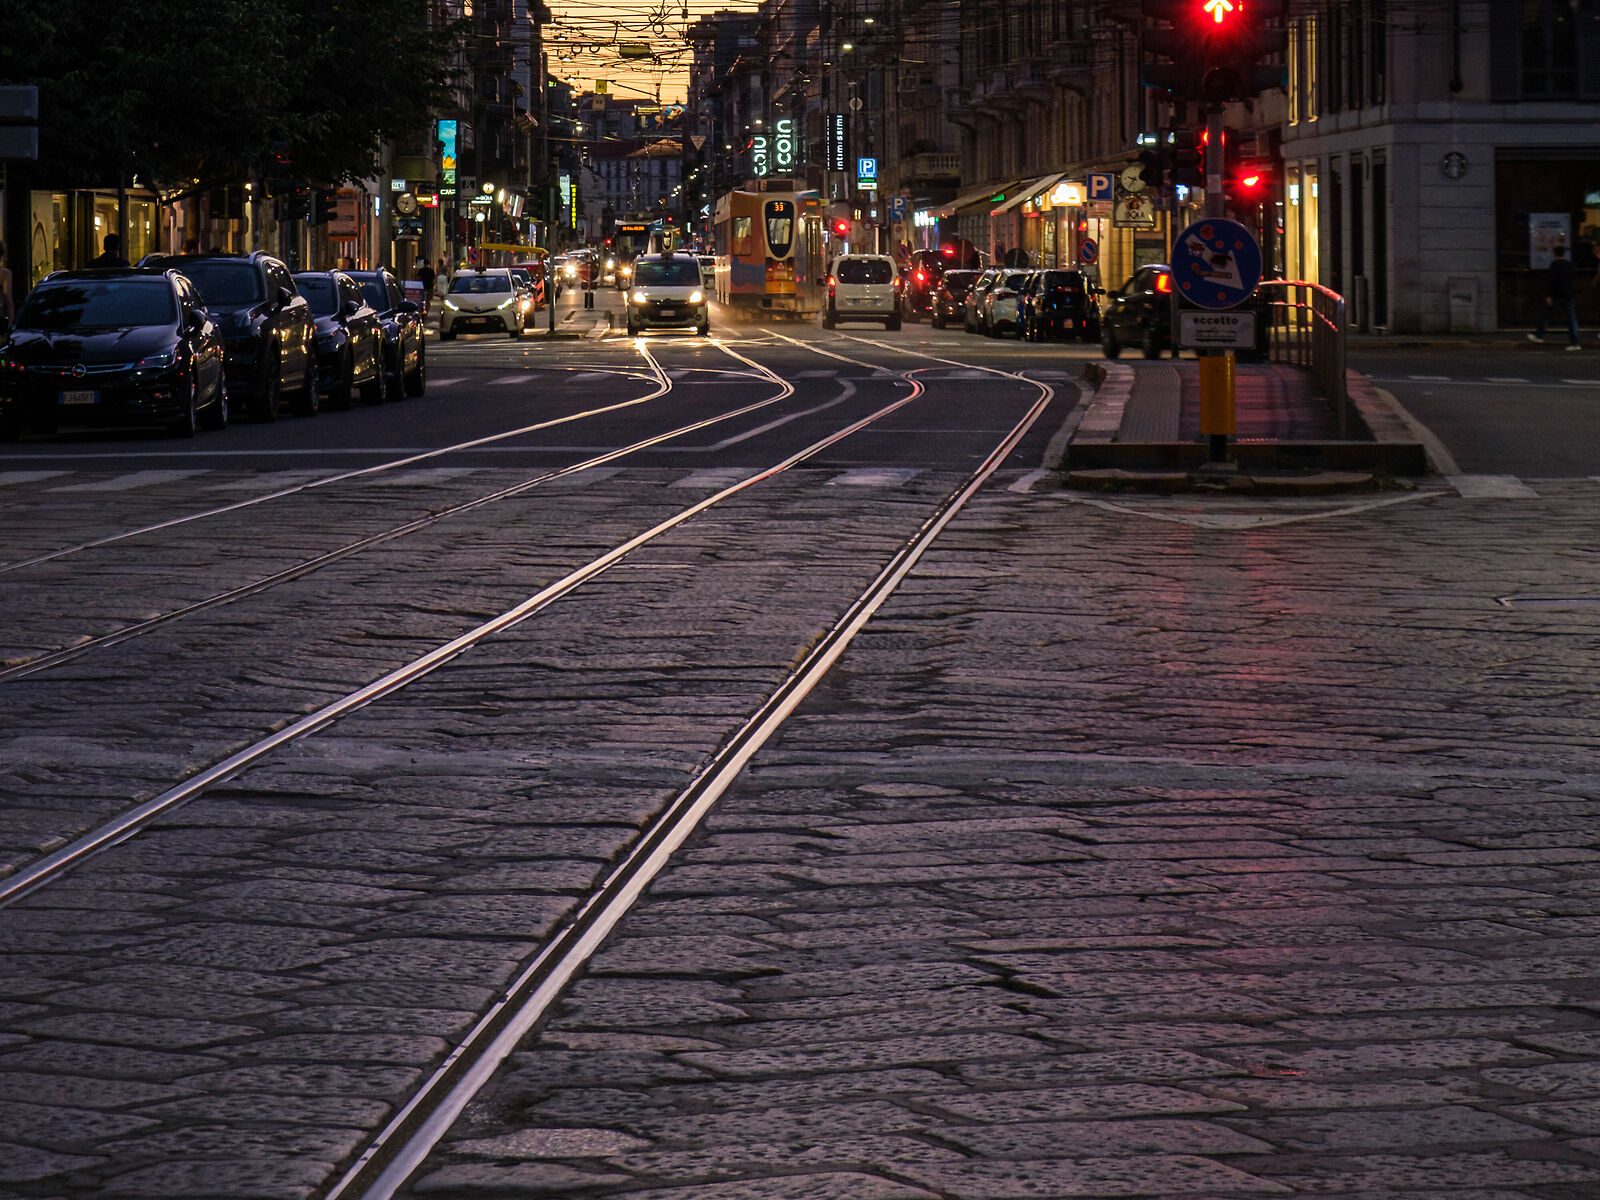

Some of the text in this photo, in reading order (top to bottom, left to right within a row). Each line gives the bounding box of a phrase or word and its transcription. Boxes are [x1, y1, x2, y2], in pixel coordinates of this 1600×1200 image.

[863, 160, 873, 173] P
[1091, 175, 1109, 197] P
[774, 202, 785, 212] 33
[894, 198, 904, 210] P
[1193, 316, 1239, 325] eccetto
